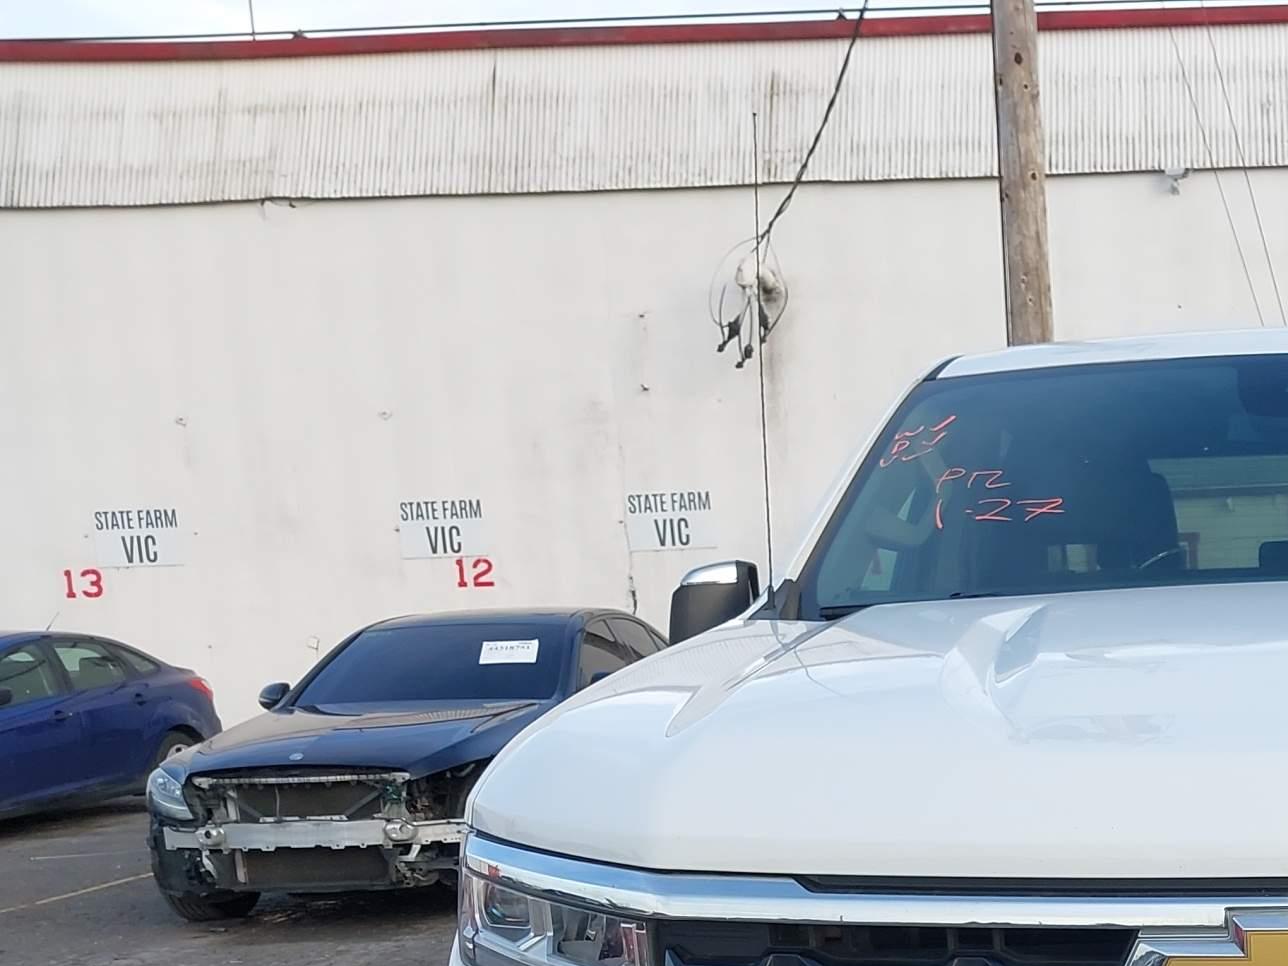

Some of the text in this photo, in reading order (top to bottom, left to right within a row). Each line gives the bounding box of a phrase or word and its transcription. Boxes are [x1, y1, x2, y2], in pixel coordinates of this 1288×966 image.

[400, 499, 482, 521] STATE FARM
[628, 491, 711, 514] STATE FARM
[94, 508, 178, 531] STATE FARM
[654, 518, 690, 546] VIC
[121, 535, 158, 563] VIC
[425, 525, 462, 554] VIC
[64, 569, 103, 598] 13
[455, 558, 495, 587] 12
